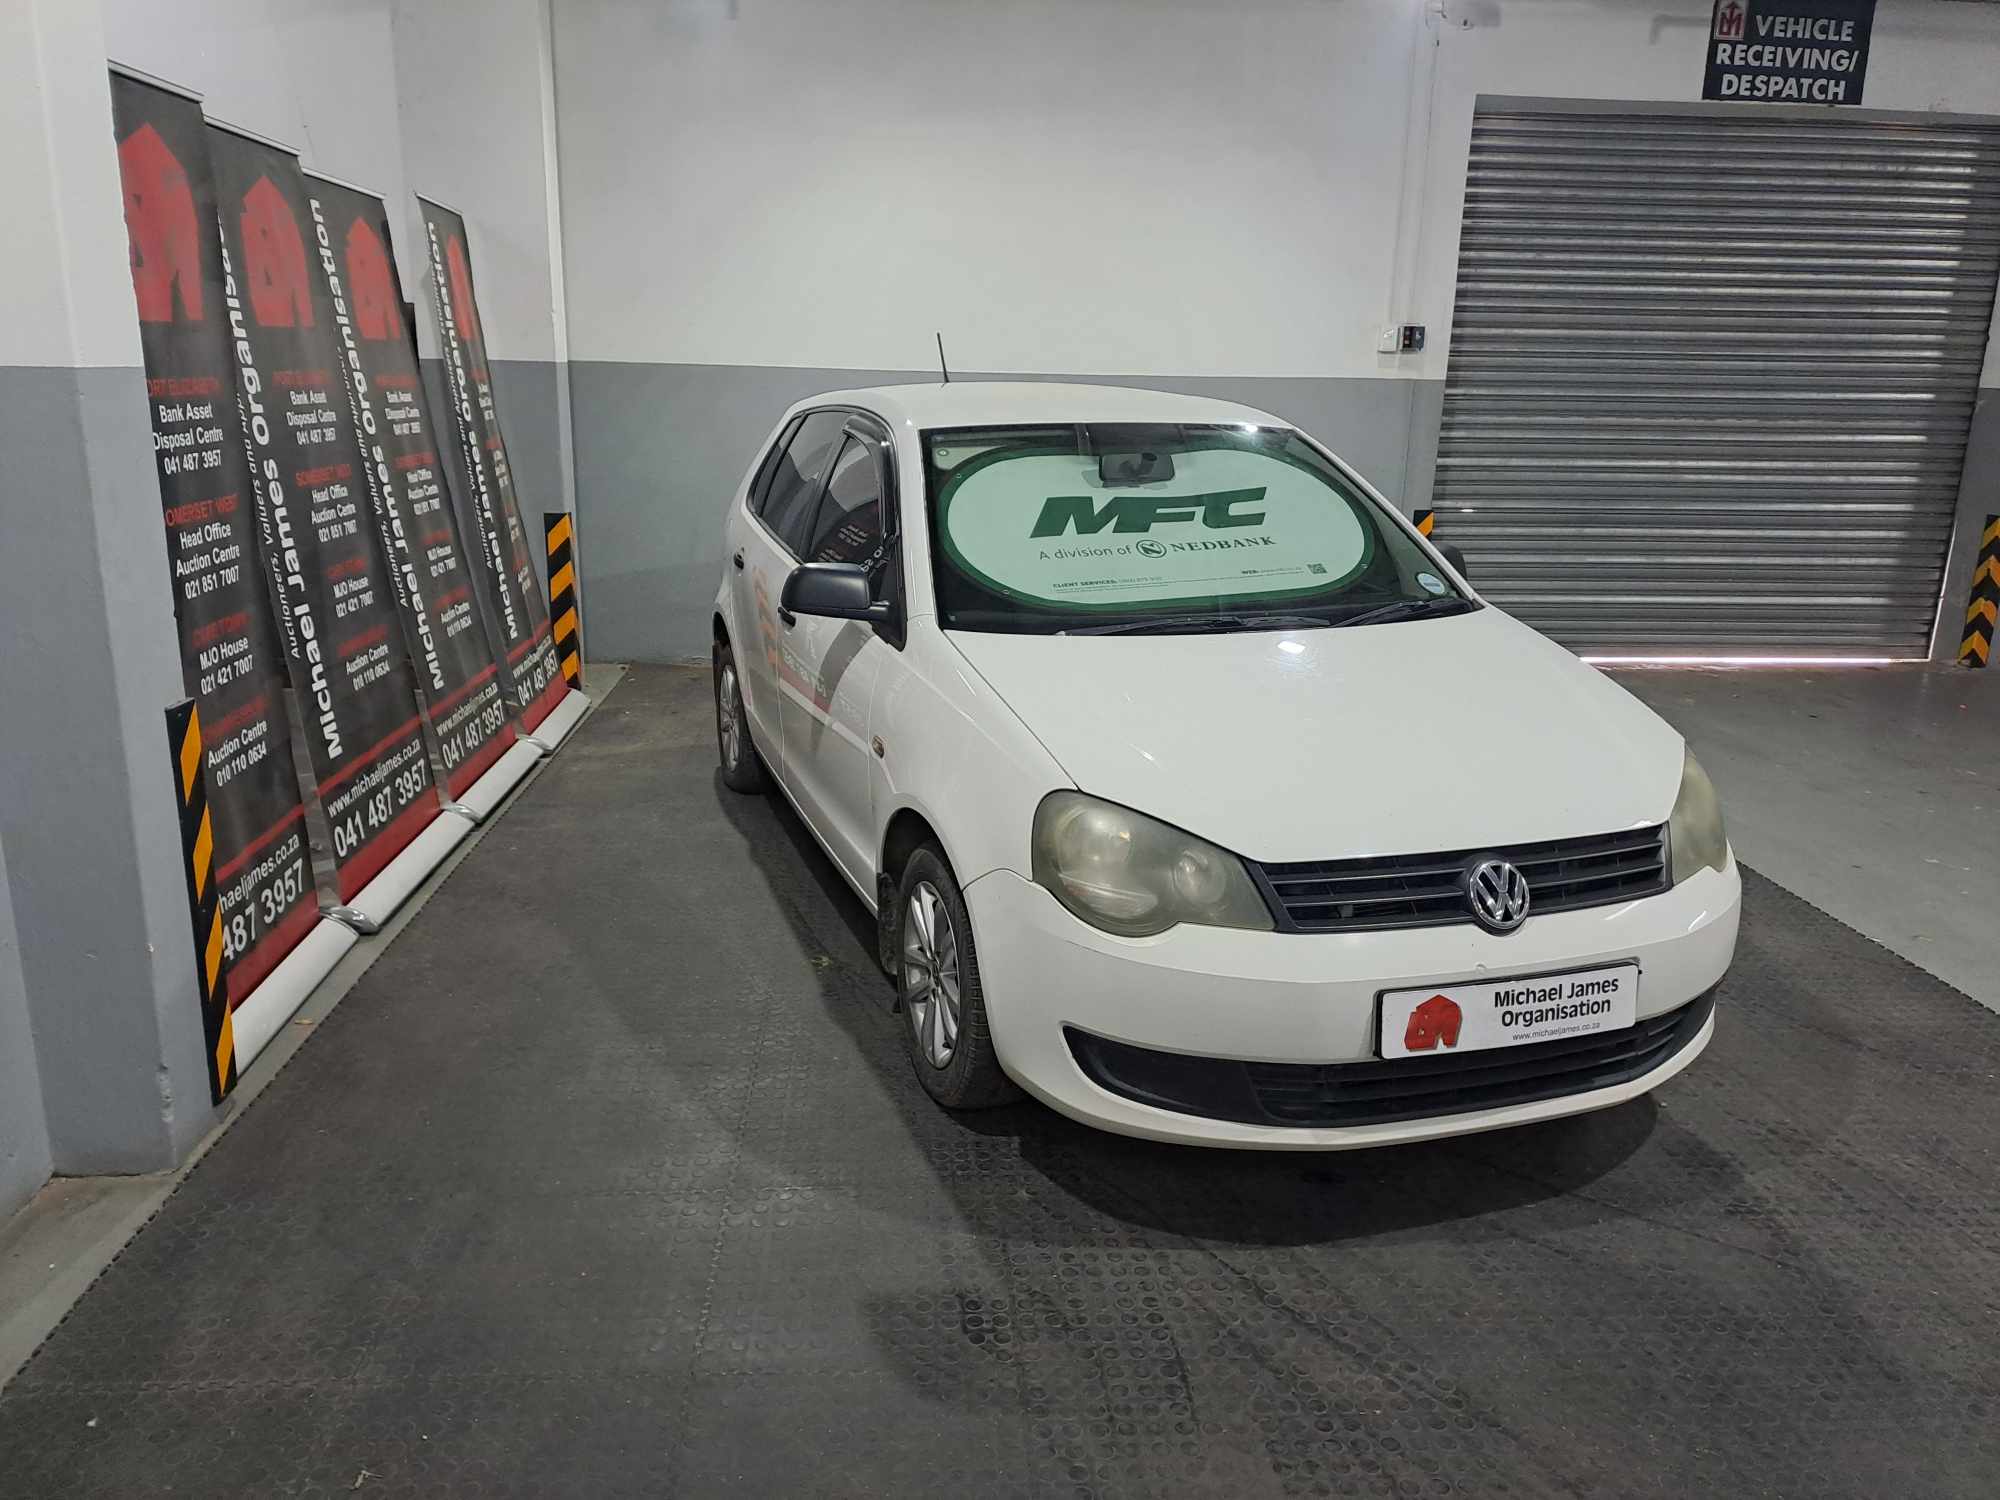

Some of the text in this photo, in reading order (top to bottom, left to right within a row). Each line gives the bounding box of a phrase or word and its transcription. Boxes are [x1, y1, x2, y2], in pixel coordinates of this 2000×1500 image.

[1756, 15, 1855, 41] VEHICLE
[1716, 43, 1859, 72] RECEIVING/
[1720, 74, 1846, 100] DESPATCH
[310, 198, 376, 435] Organisation
[428, 221, 472, 422] Organisation
[159, 401, 213, 423] Bank Asset
[289, 390, 308, 405] Bank
[286, 410, 318, 428] Disposal
[152, 426, 223, 452] Disposal Centre
[296, 430, 309, 445] 041
[310, 428, 322, 444] 487
[355, 428, 368, 457] and
[164, 449, 221, 475] 041 487 3957
[468, 430, 493, 523] James
[311, 487, 329, 504] Head
[364, 461, 382, 514] Valuers
[372, 445, 408, 553] James
[166, 499, 213, 527] OMERSET
[253, 479, 274, 544] Valuers
[263, 458, 305, 592] James
[311, 507, 337, 524] Auction
[1030, 486, 1267, 539] MFC
[180, 522, 231, 549] Head Office
[318, 527, 331, 543] 021
[1039, 551, 1050, 560] A
[1054, 546, 1113, 560] division
[1117, 544, 1131, 555] of
[1170, 536, 1277, 552] NEDBANK
[176, 544, 240, 577] Auction Centre
[381, 520, 408, 607] Auctioneers,
[185, 565, 239, 599] 021 851 7007
[347, 576, 369, 592] House
[487, 530, 518, 639] Michael
[271, 552, 300, 658] Auctioneers,
[335, 601, 348, 618] 021
[347, 597, 359, 612] 421
[401, 563, 444, 690] Michael
[199, 637, 248, 670] MJO House
[345, 644, 389, 675] Auction Centre
[200, 654, 253, 695] 021 421 7007
[294, 603, 343, 760] Michael
[518, 676, 533, 706] 041
[207, 737, 240, 768] Auction
[241, 719, 267, 745] Centre
[442, 699, 505, 769] 041 487 3957
[216, 740, 267, 787] 010 110 0634
[327, 738, 421, 818] www.michaeljames.co.za
[334, 758, 426, 858] 041 487 3957
[218, 833, 300, 914] haeljames.co.za
[222, 857, 303, 961] 487 3957
[1494, 978, 1619, 1008] Michael James
[1501, 999, 1611, 1027] Organisation
[1513, 1022, 1600, 1041] www.michaeljames.co.za
